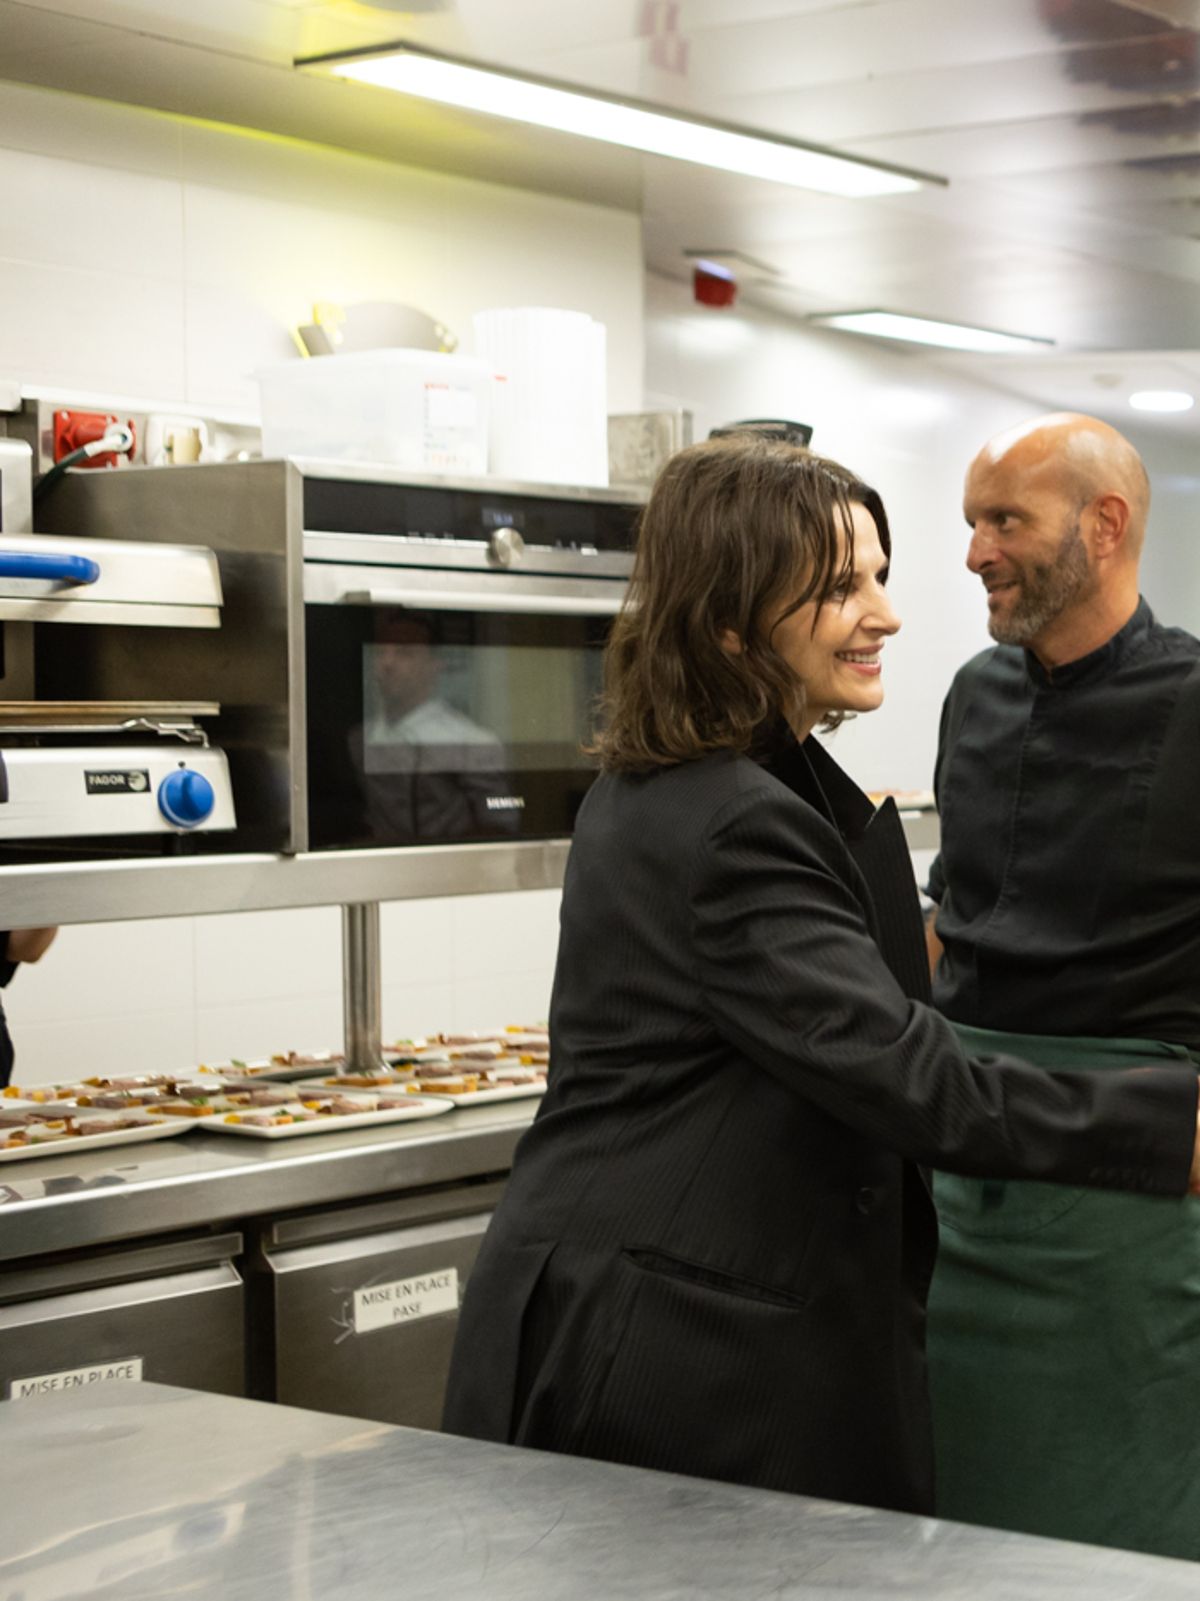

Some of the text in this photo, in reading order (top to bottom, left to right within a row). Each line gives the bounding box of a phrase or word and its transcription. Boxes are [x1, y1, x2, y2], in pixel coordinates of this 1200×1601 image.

[88, 774, 125, 786] FAGOR
[361, 1274, 450, 1307] MISE EN PLACE
[392, 1302, 421, 1319] PASE
[20, 1364, 134, 1398] MISE EN PLACE
